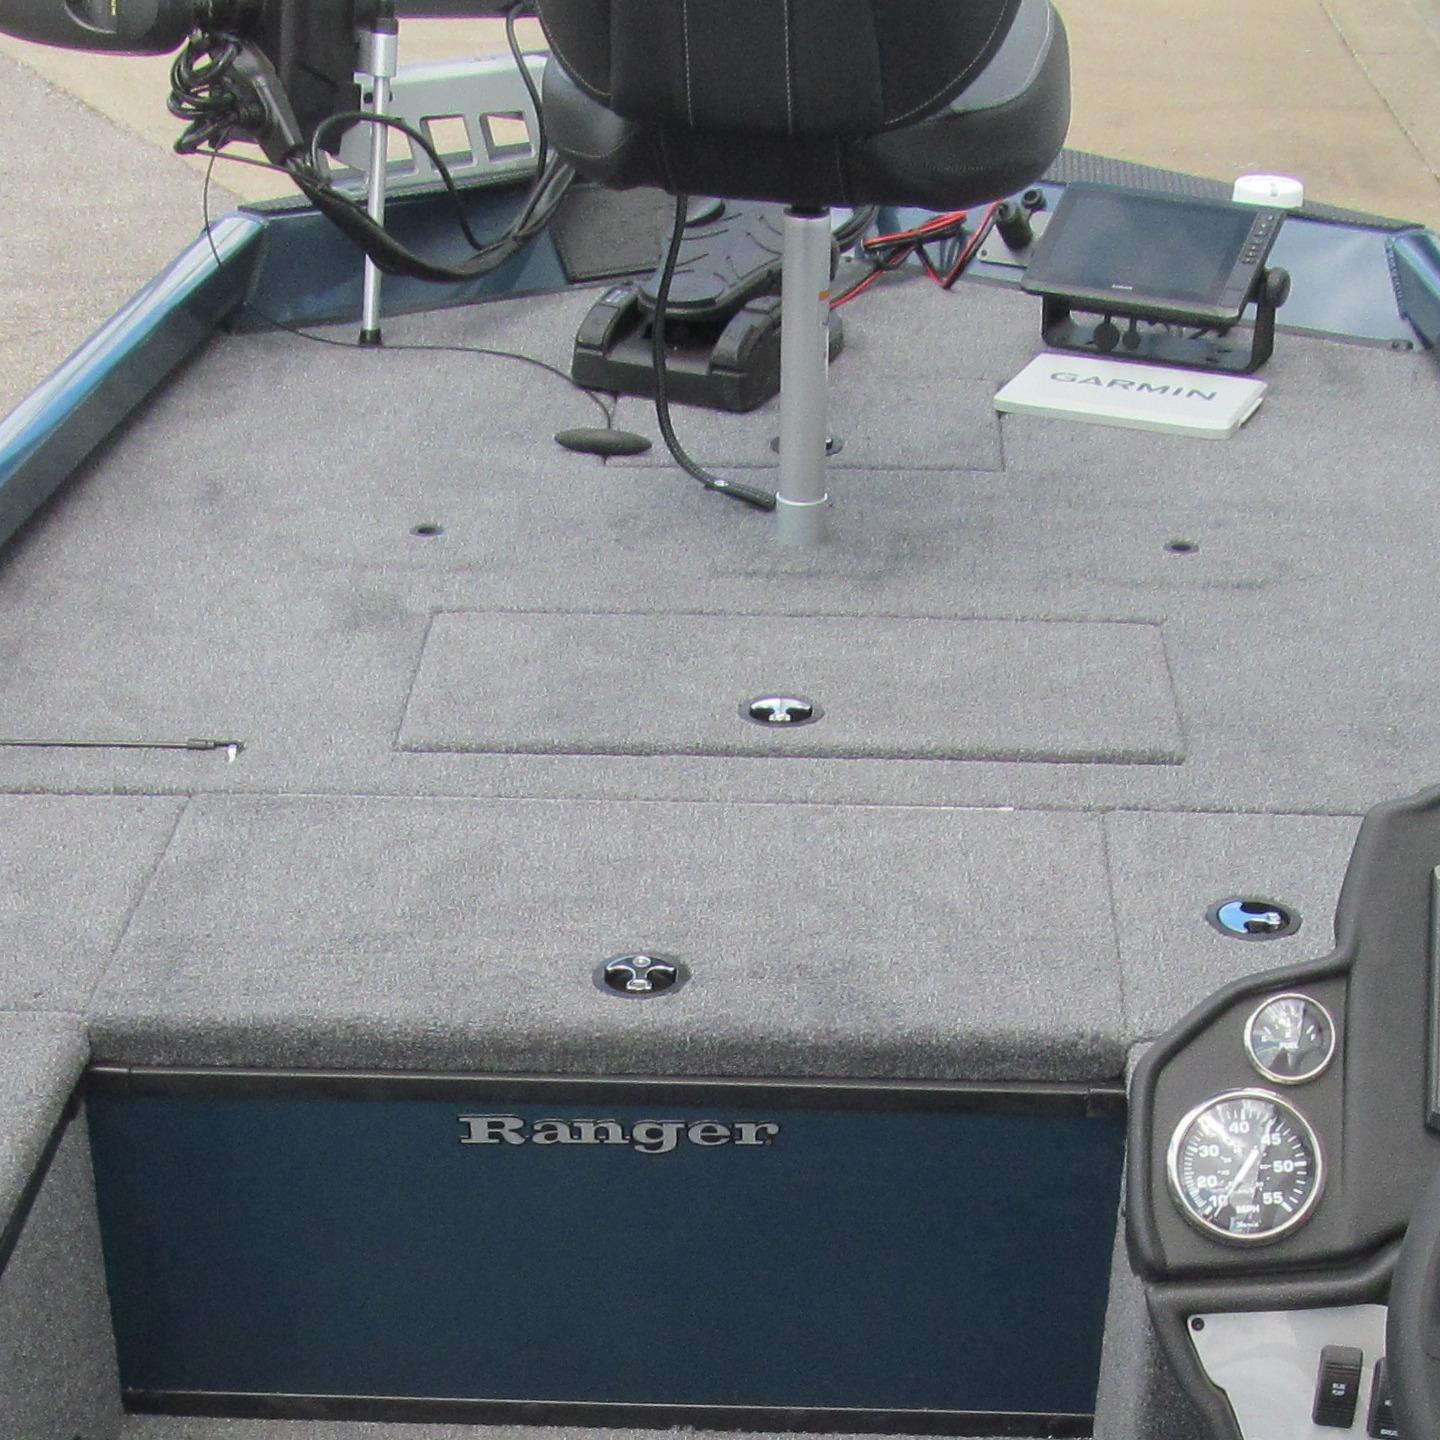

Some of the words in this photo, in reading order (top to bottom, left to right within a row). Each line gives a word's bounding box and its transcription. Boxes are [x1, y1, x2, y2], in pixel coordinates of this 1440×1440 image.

[1049, 371, 1218, 401] GARMIN
[457, 1113, 780, 1153] Ranger
[1229, 1121, 1250, 1134] 40
[1260, 1133, 1282, 1145] 45
[1198, 1144, 1219, 1157] 30
[1272, 1160, 1294, 1173] 50
[1196, 1175, 1218, 1188] 20
[1208, 1195, 1229, 1207] 10
[1262, 1191, 1284, 1205] 55
[1235, 1204, 1260, 1213] MPH
